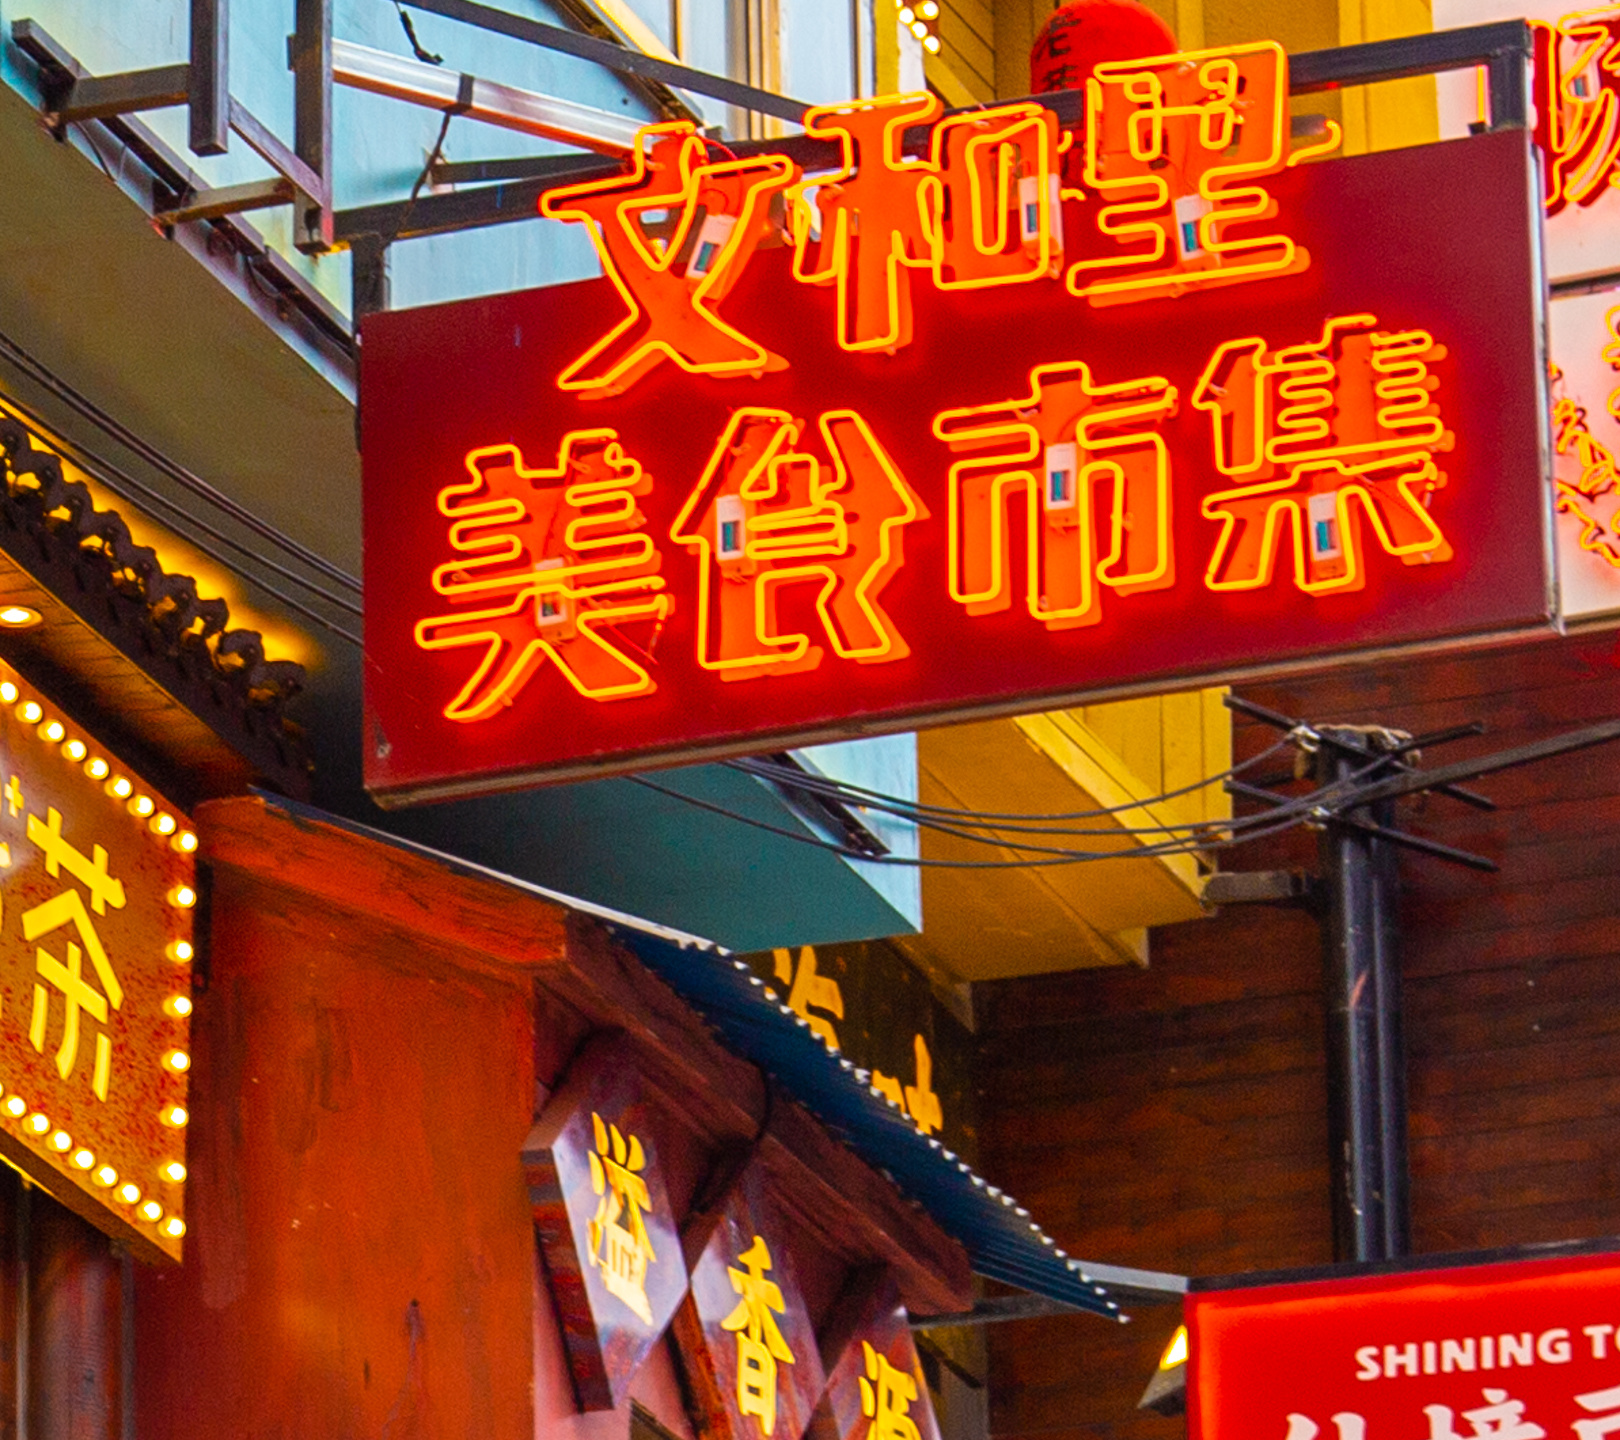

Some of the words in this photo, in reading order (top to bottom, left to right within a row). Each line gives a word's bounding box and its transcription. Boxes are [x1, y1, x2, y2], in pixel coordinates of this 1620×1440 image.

[541, 40, 1316, 402] 文和里
[413, 313, 1456, 726] 美食市集
[1354, 1327, 1572, 1382] SHINING
